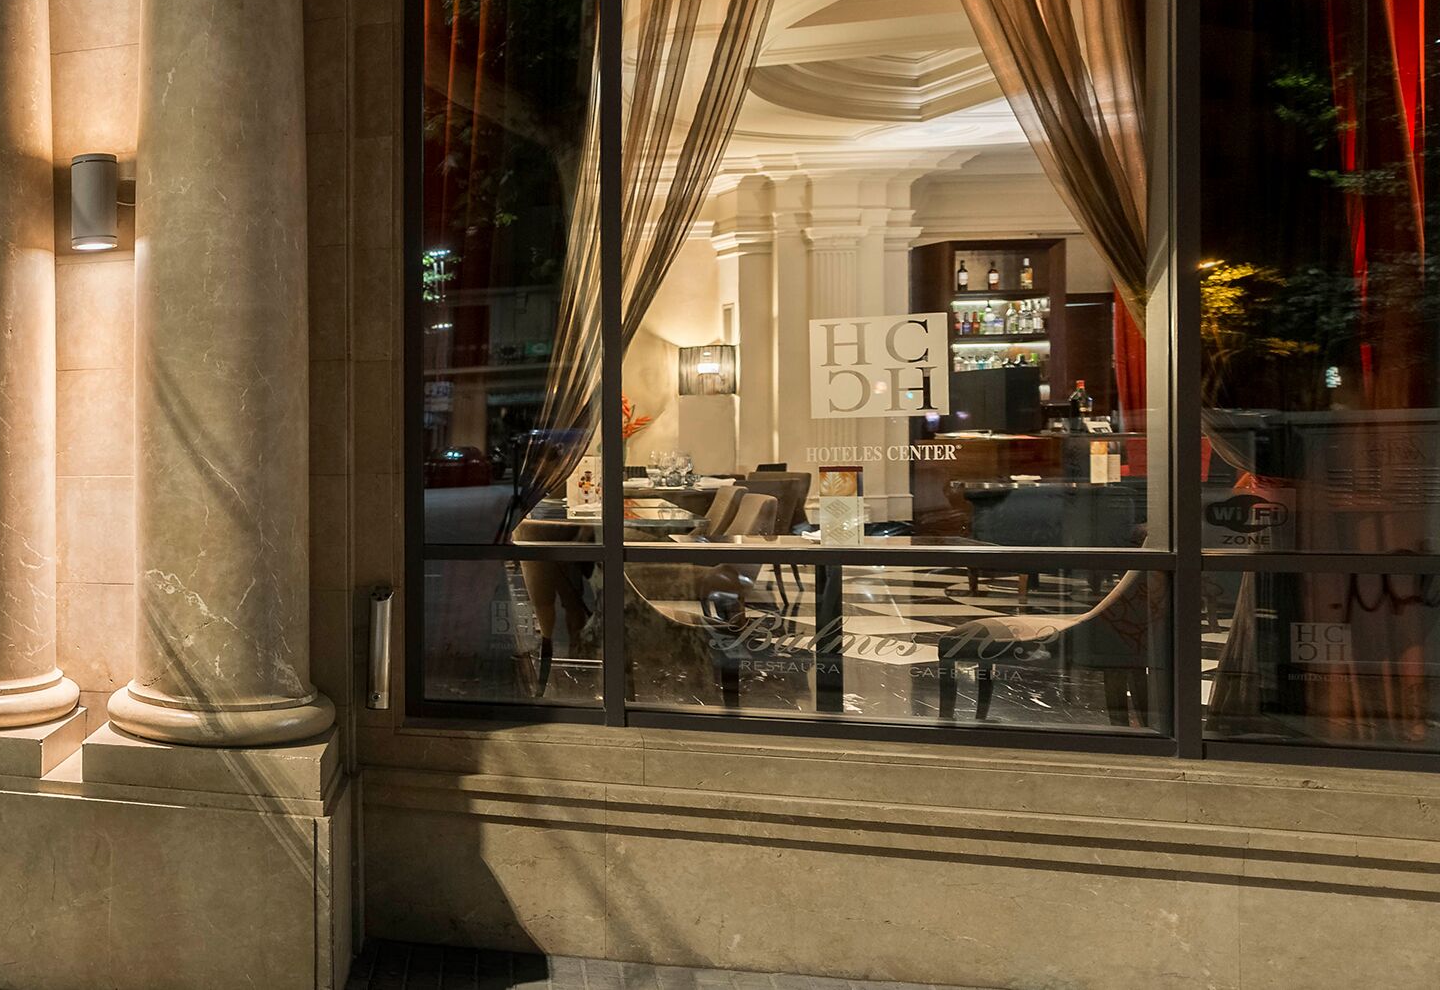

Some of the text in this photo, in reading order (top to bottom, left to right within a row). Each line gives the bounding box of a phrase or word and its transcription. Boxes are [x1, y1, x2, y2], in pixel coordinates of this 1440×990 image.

[806, 445, 883, 462] HOTELES
[1222, 535, 1271, 545] ZONE
[702, 609, 928, 657] Balmes
